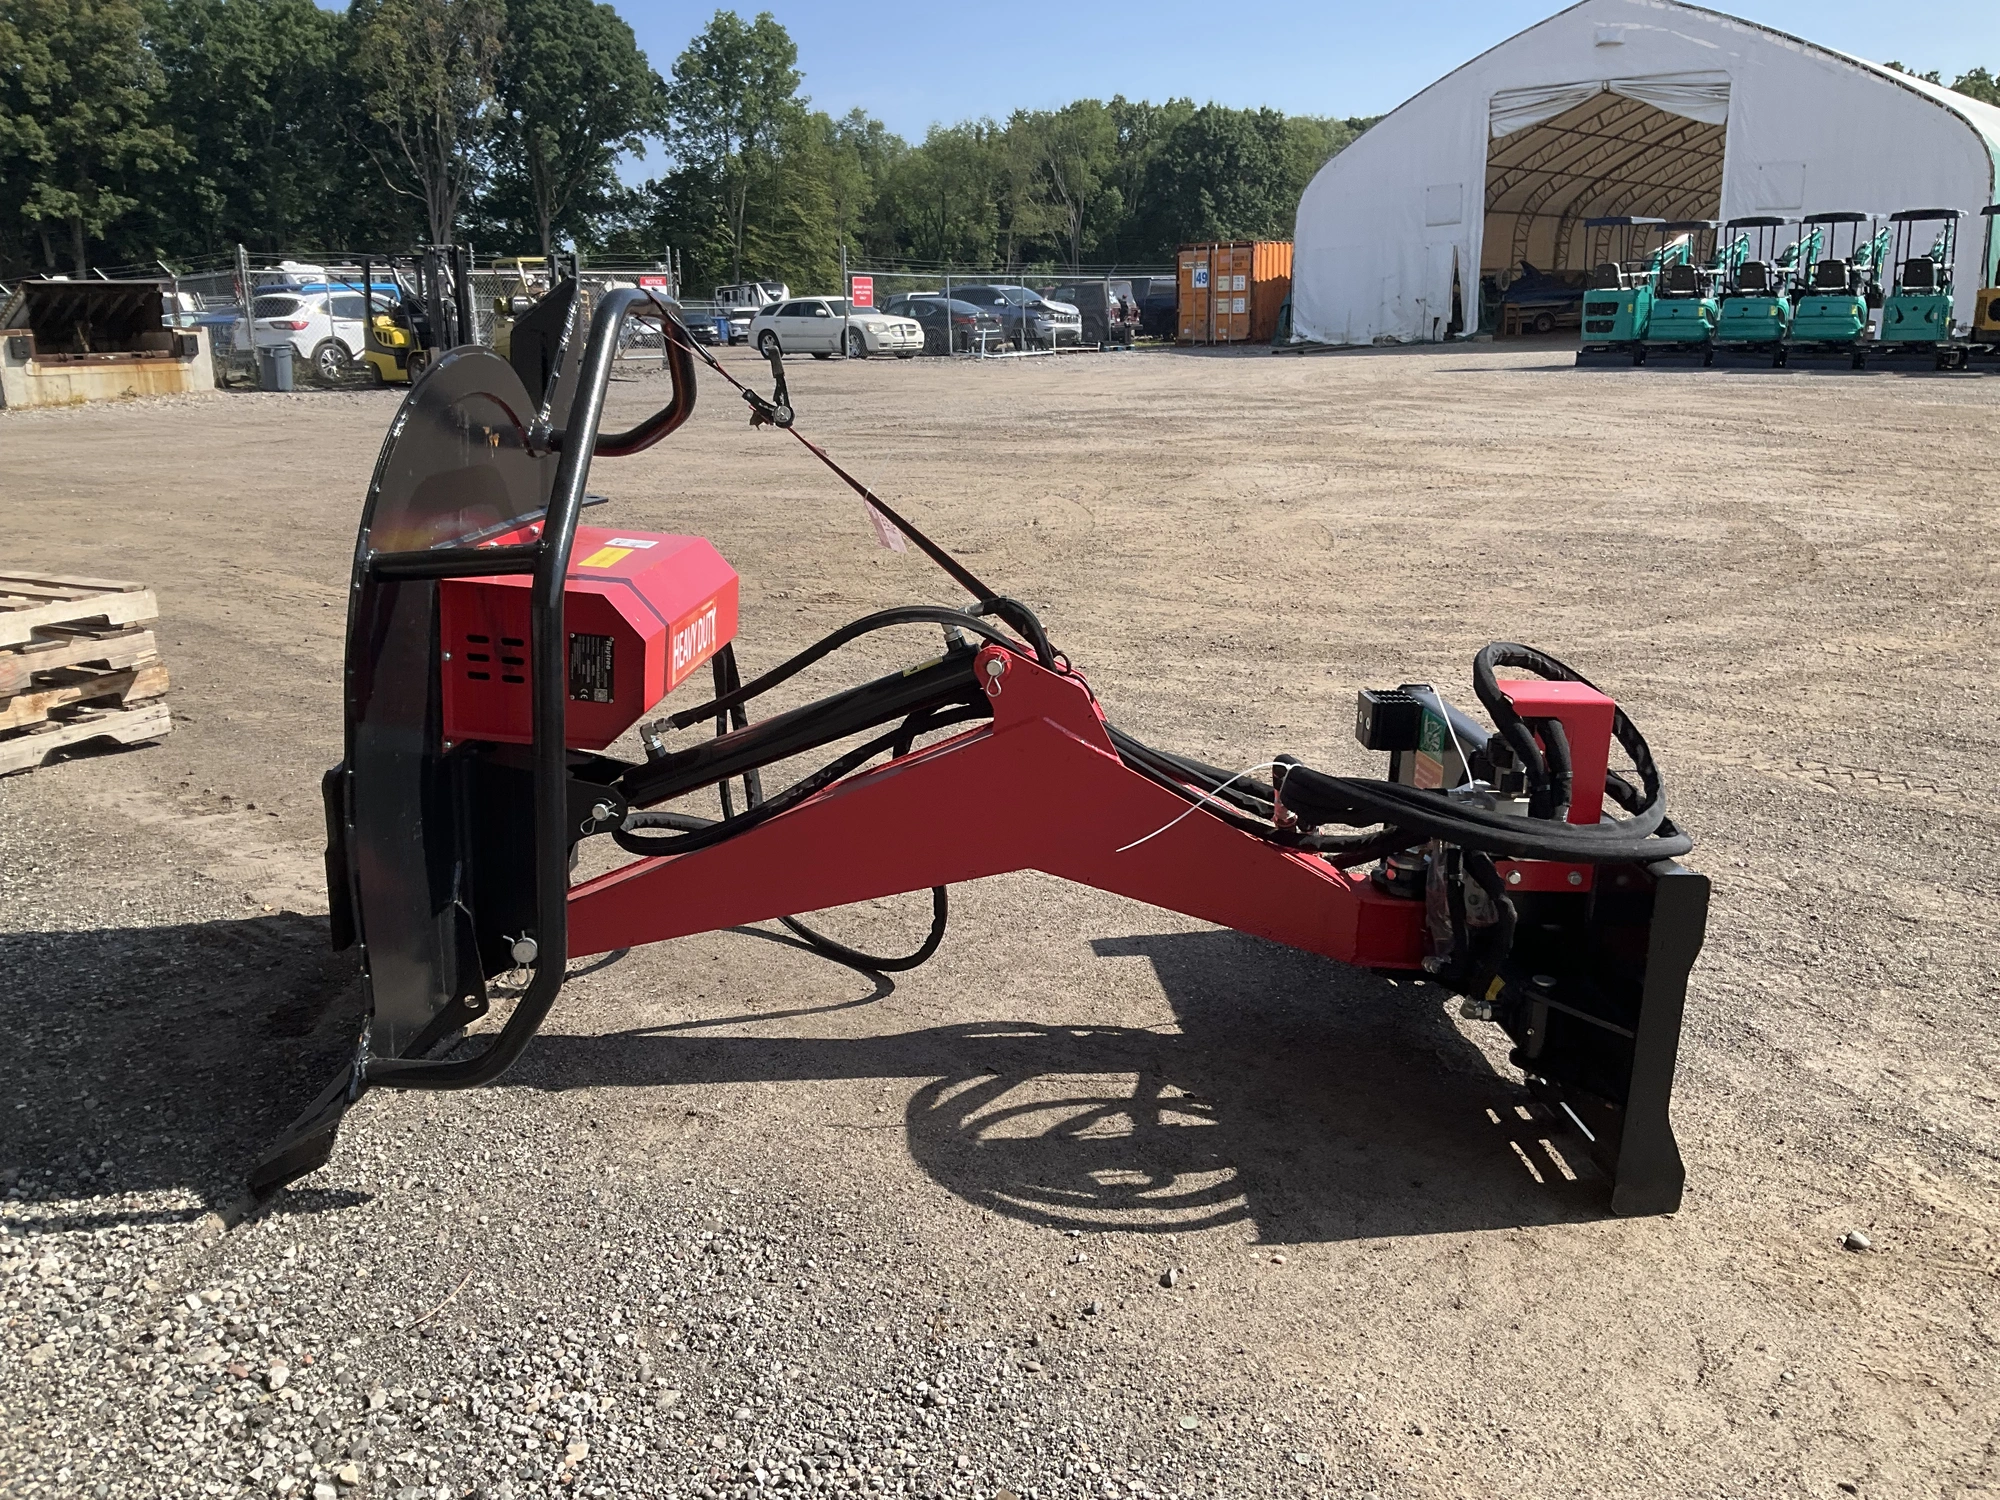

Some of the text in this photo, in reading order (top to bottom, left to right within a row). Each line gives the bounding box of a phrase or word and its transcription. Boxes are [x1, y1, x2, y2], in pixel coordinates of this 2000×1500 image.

[1196, 272, 1208, 284] 49
[674, 607, 717, 671] HEAVY DUTY
